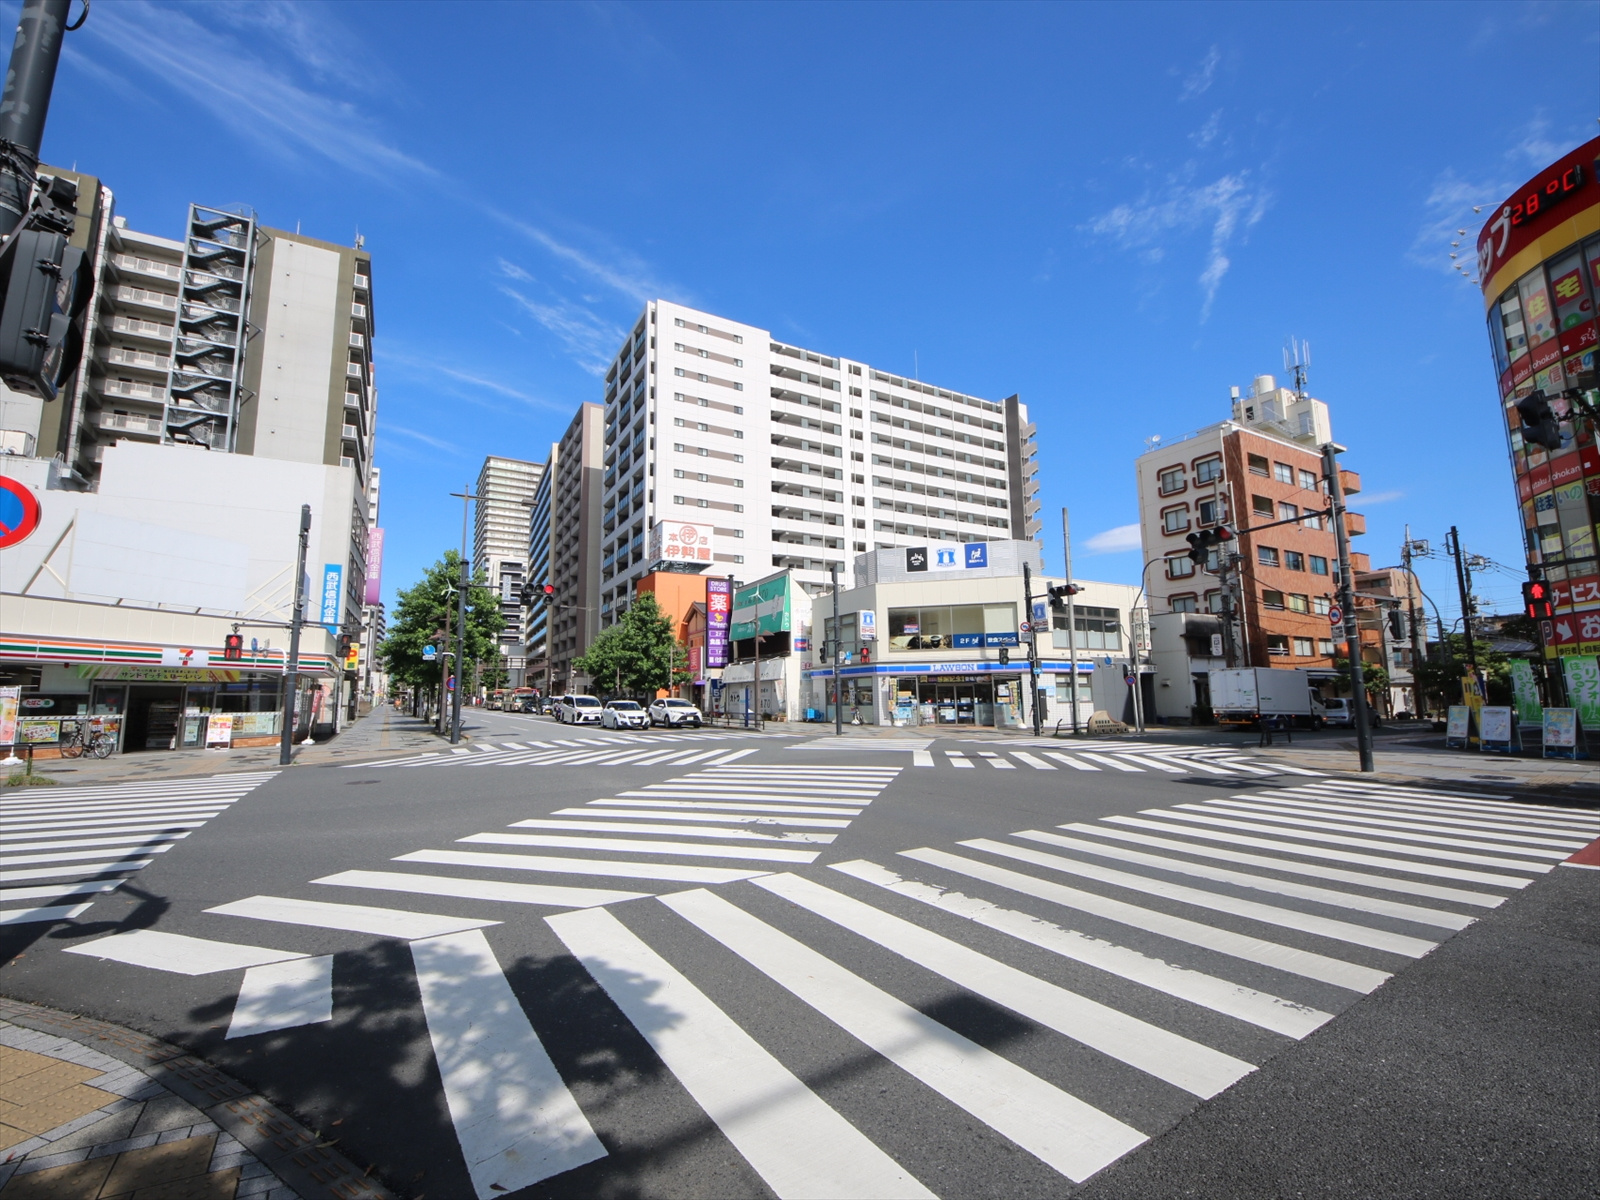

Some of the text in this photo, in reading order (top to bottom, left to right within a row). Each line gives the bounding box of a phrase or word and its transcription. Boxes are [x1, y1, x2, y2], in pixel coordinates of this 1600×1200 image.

[1511, 193, 1539, 225] 28
[710, 594, 727, 611] 薬
[933, 664, 975, 672] LAWSON
